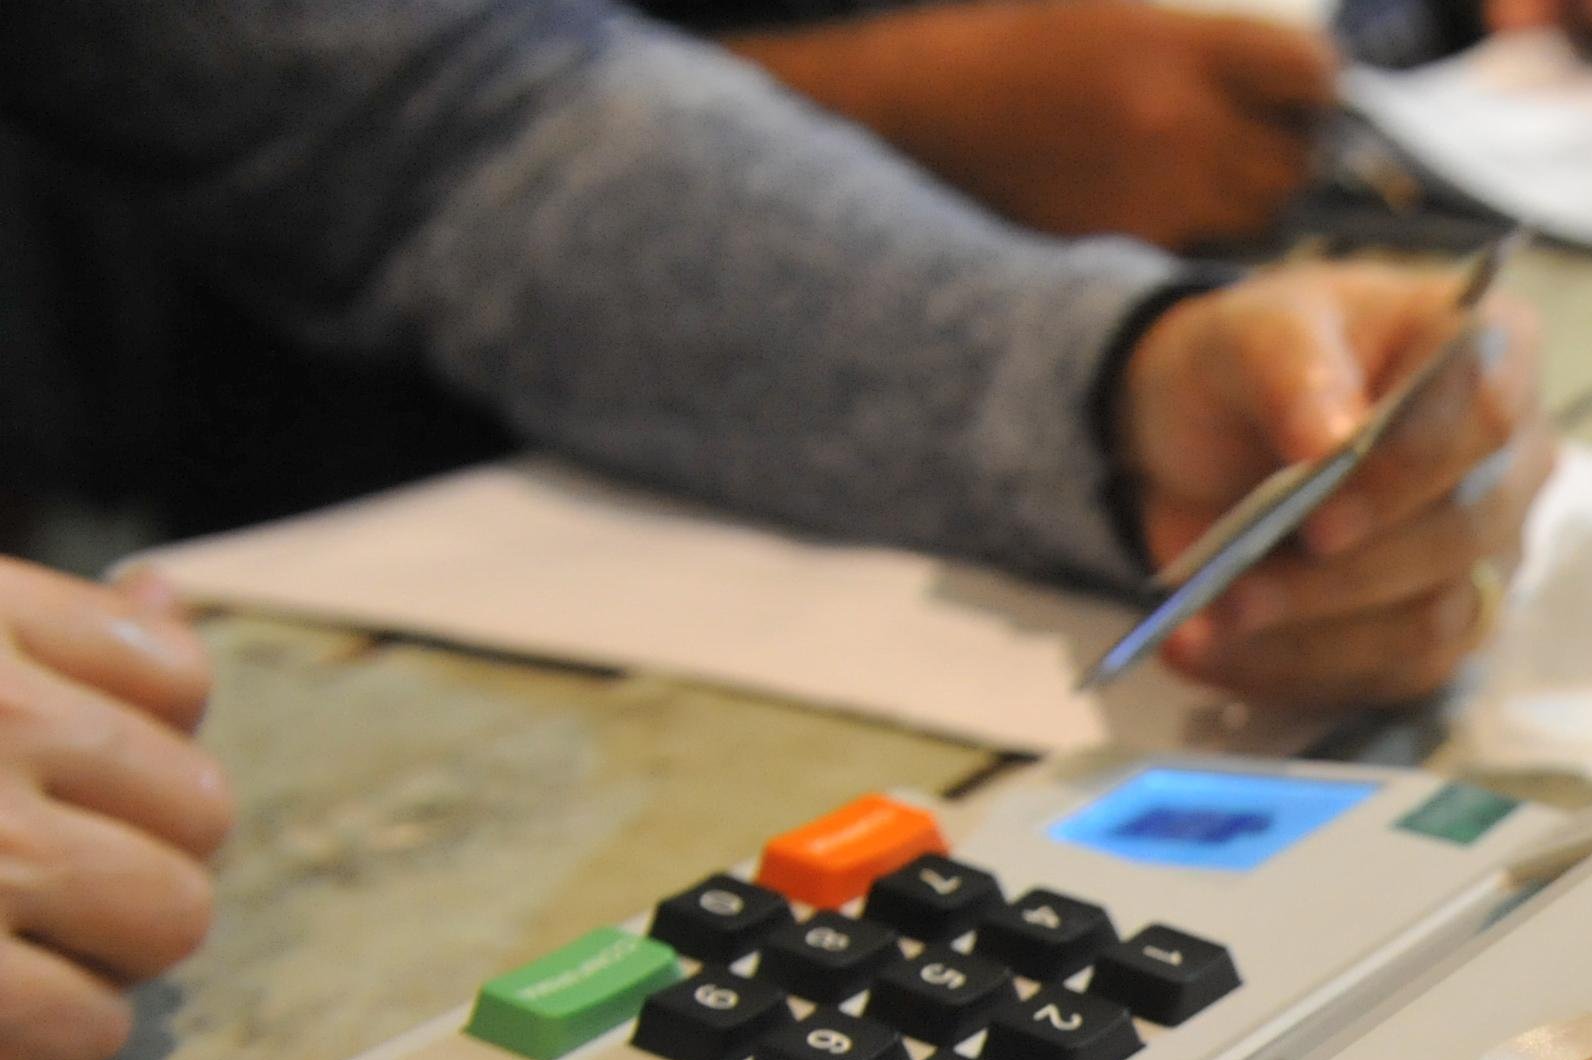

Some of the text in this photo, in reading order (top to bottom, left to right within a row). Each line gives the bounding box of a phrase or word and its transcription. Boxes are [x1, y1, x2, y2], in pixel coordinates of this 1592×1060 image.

[922, 870, 961, 895] 7
[699, 889, 743, 915] 0
[1022, 905, 1060, 929] 4
[804, 927, 849, 951] 8
[1142, 945, 1183, 967] 1
[919, 963, 966, 990] 5
[693, 984, 739, 1010] 9
[1033, 1003, 1083, 1031] 2
[806, 1028, 853, 1055] 6
